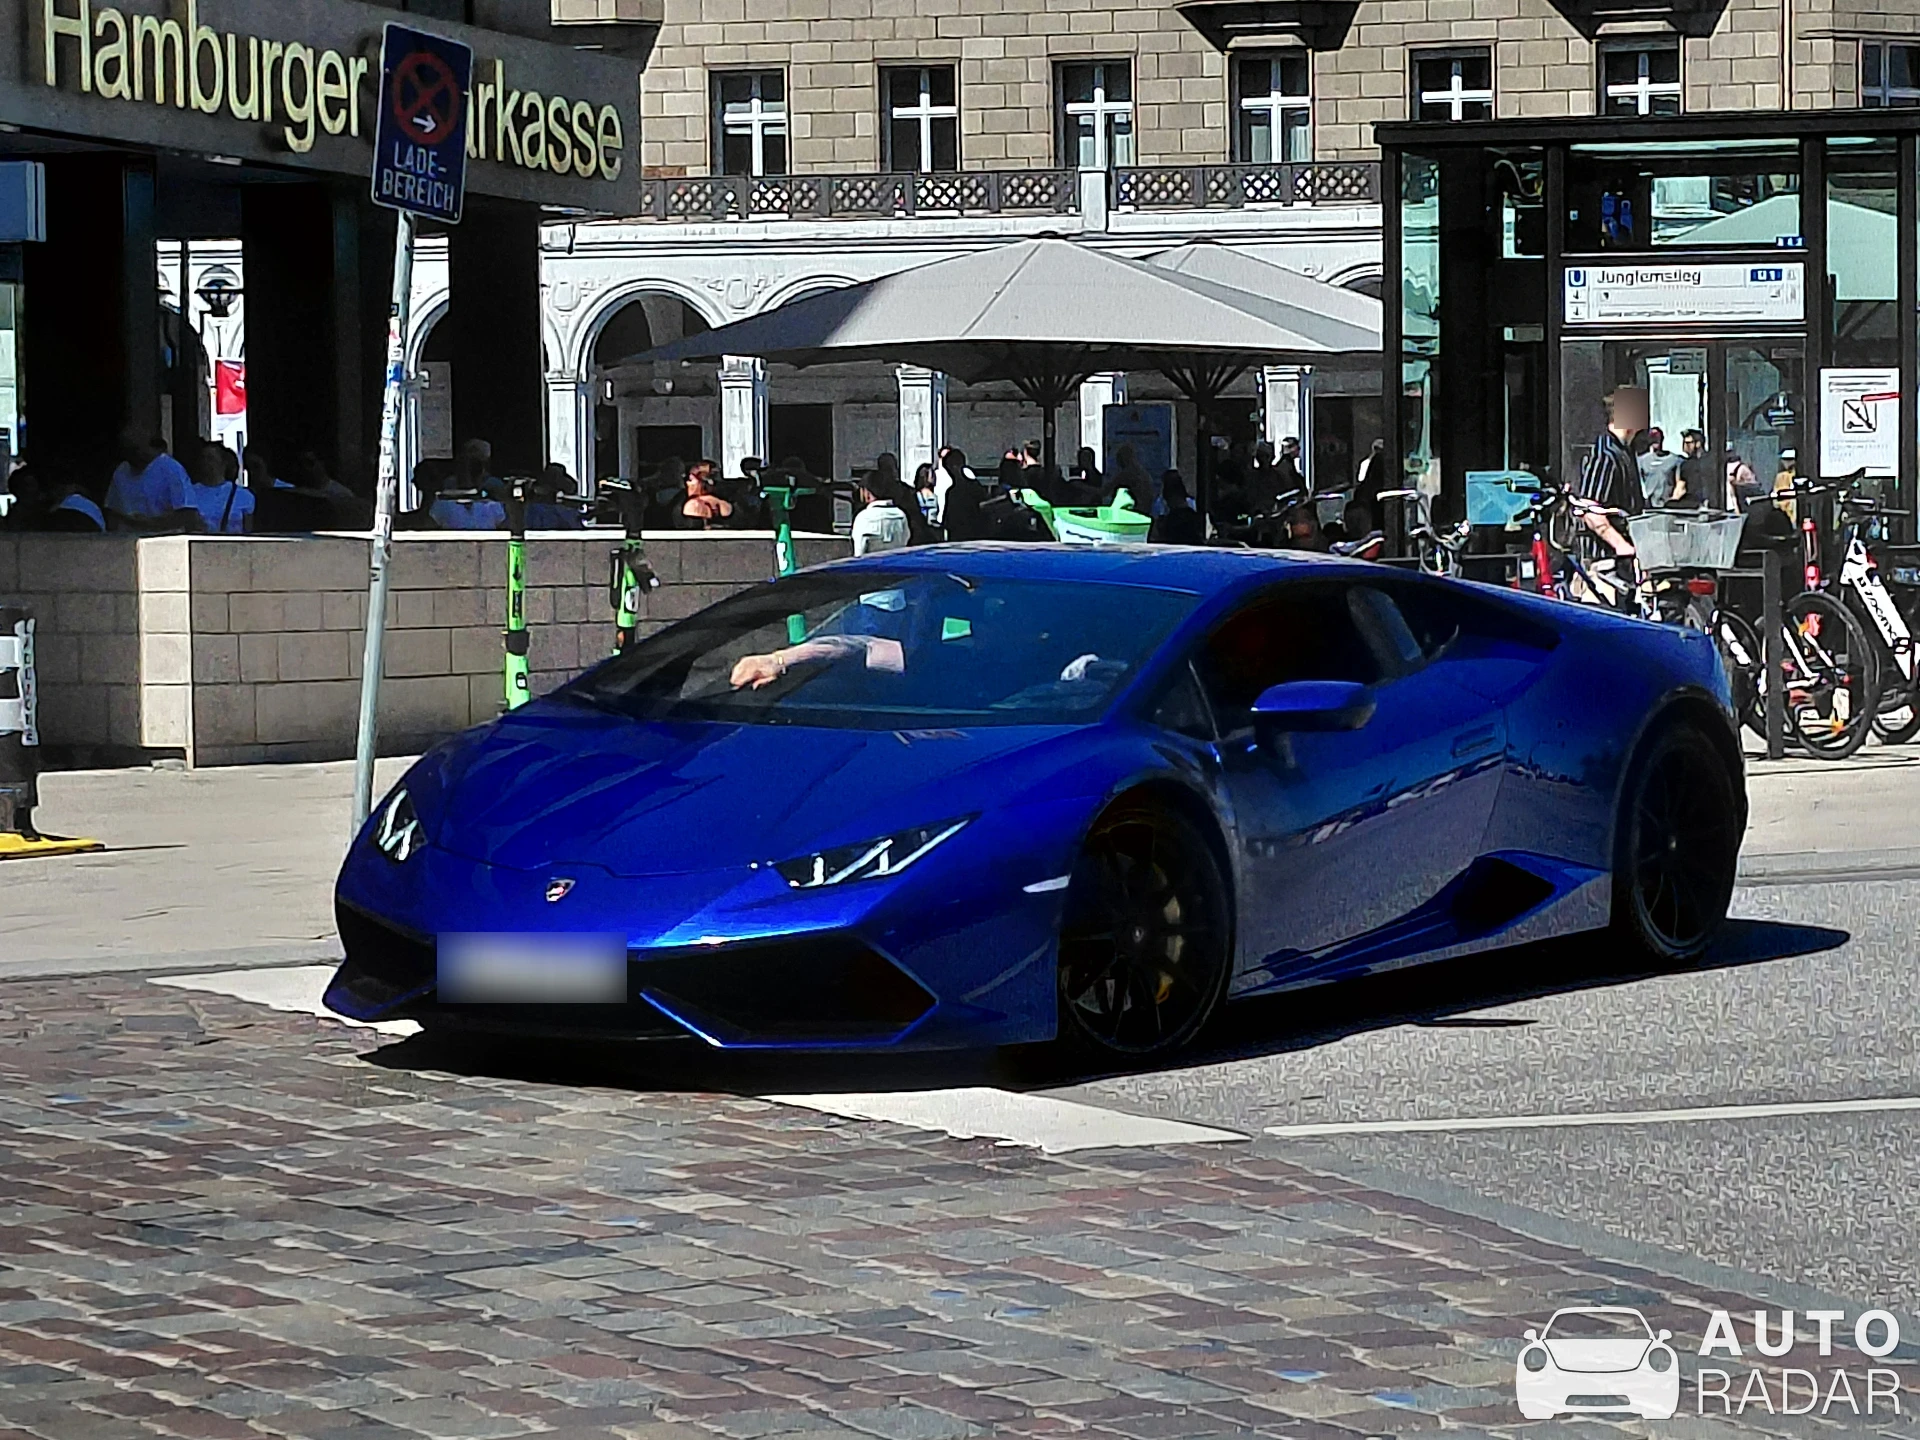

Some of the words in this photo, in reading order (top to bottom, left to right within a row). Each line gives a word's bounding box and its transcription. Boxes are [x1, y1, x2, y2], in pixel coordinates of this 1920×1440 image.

[44, 0, 367, 153] Hamburger
[393, 142, 448, 176] LADE-
[382, 168, 455, 211] BEREICH
